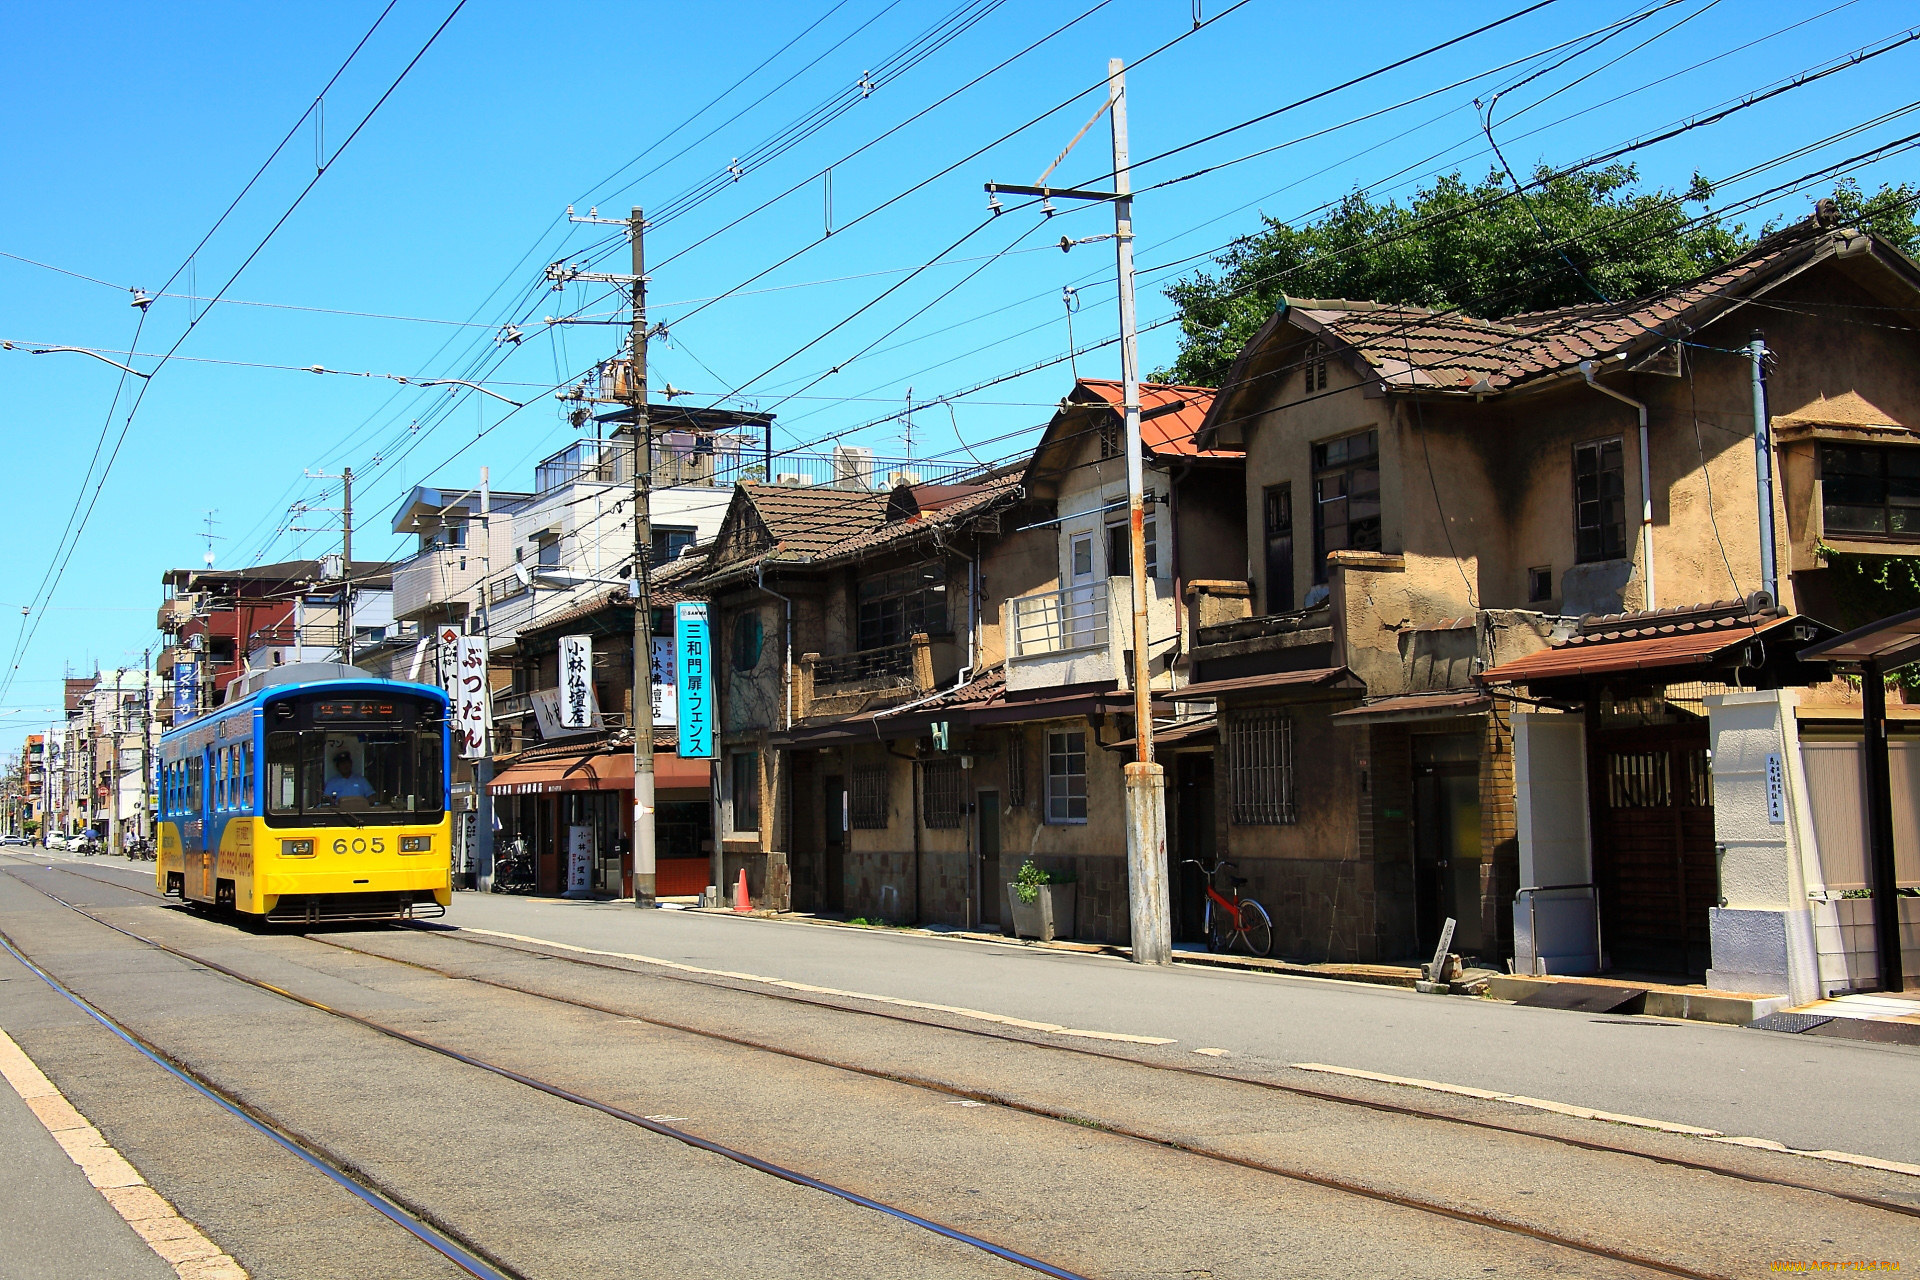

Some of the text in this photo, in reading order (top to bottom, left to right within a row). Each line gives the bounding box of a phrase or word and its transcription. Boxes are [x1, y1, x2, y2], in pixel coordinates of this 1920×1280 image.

[462, 647, 482, 749] ぶつだん
[567, 641, 587, 724] 小林仏壇店
[686, 624, 703, 753] 三和門扉・フェンス
[1769, 757, 1779, 818] 患者様用駐車場
[332, 837, 385, 855] 605
